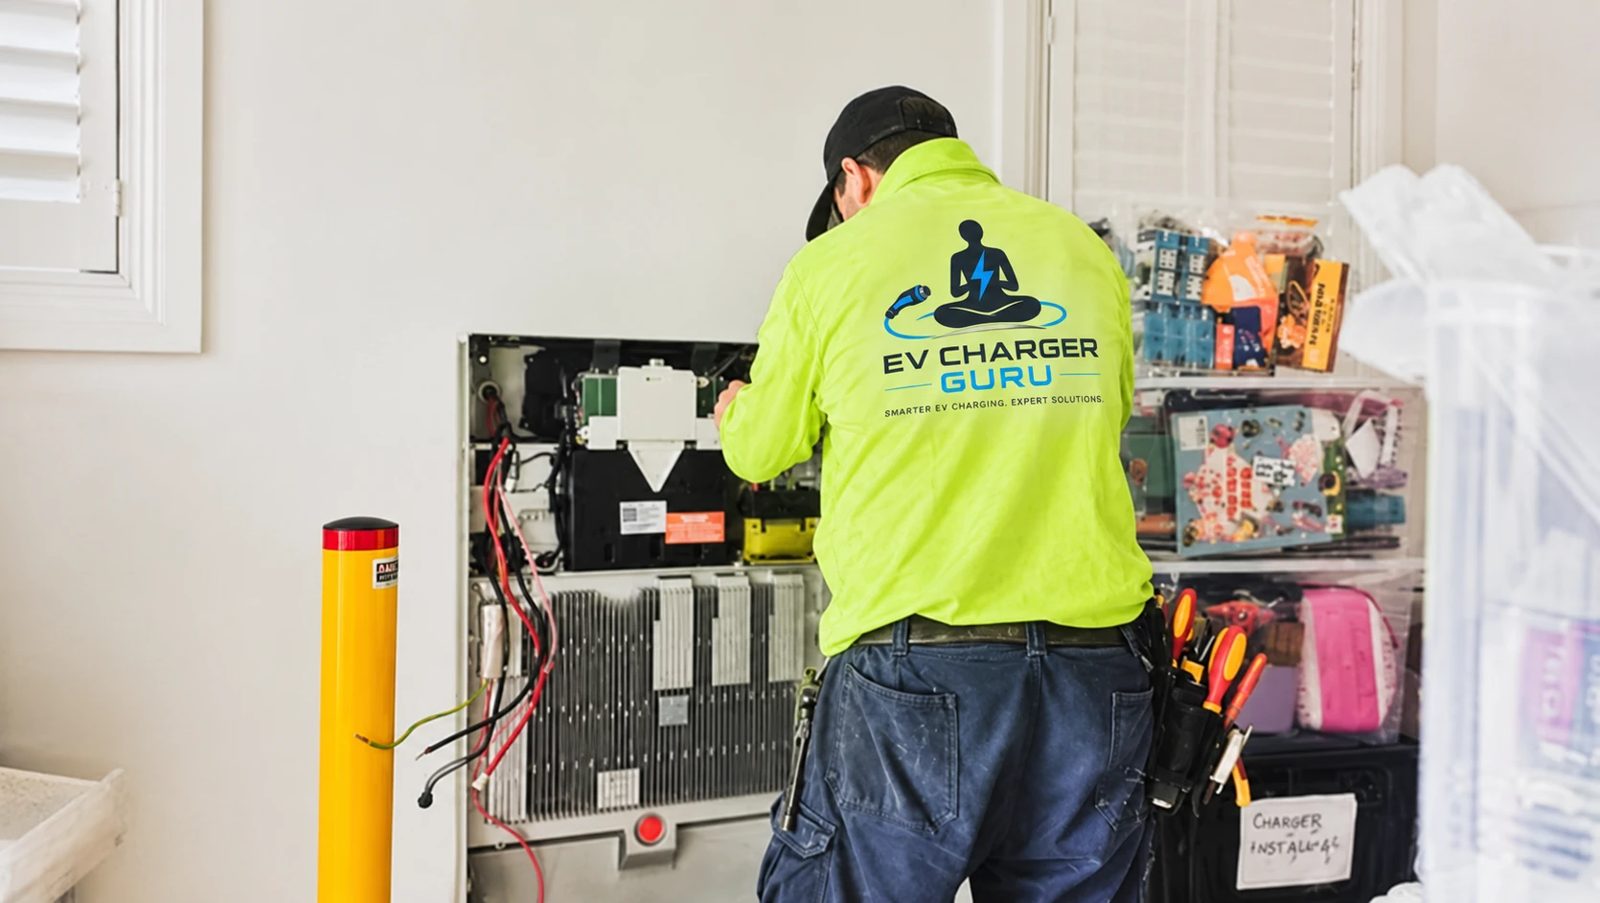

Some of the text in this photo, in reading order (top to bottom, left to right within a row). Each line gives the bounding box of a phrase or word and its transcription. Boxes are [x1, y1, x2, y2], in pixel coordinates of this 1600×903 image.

[883, 338, 1099, 374] EV CHARGER
[941, 365, 1052, 393] GURU
[884, 395, 1105, 417] SMARTER EV CHARGING. EXPERT SOLUTIONS.
